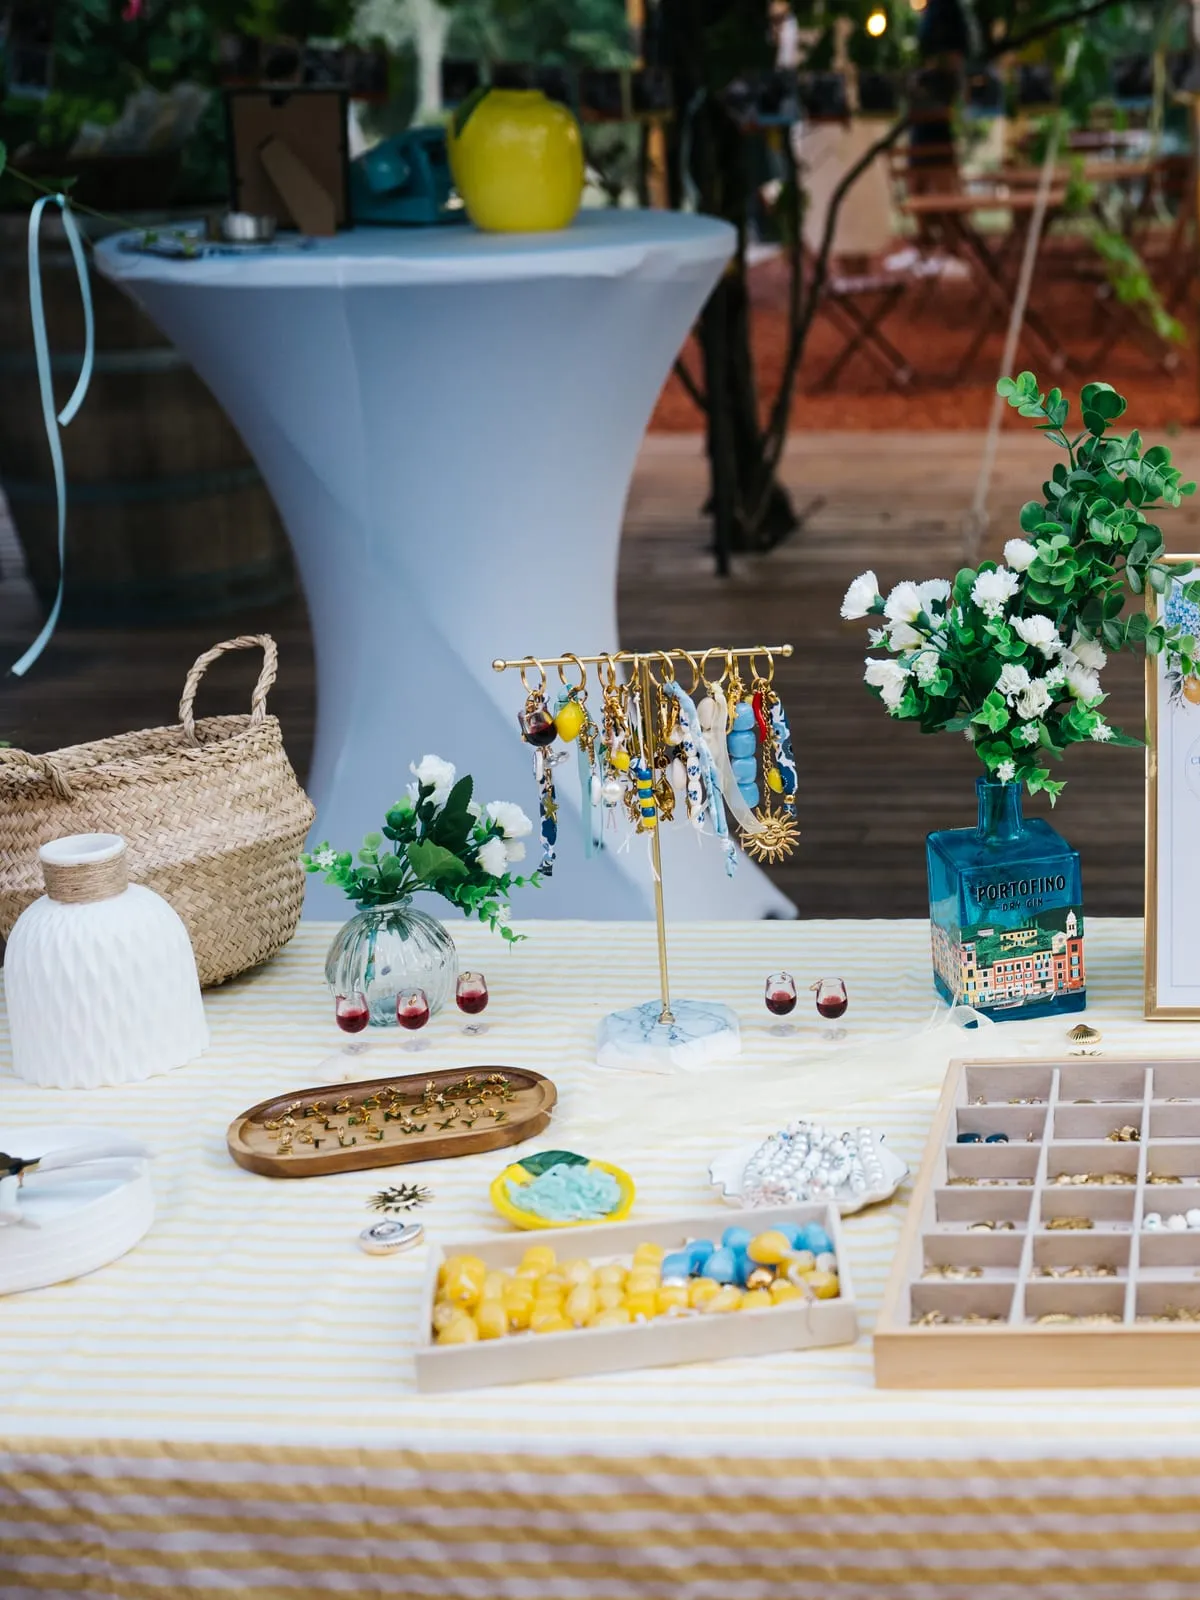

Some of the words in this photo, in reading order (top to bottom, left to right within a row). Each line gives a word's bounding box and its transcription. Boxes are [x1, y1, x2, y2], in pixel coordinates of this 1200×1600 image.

[976, 874, 1066, 902] PORTOFINO
[1001, 900, 1021, 912] DRY
[1025, 897, 1043, 908] GIN
